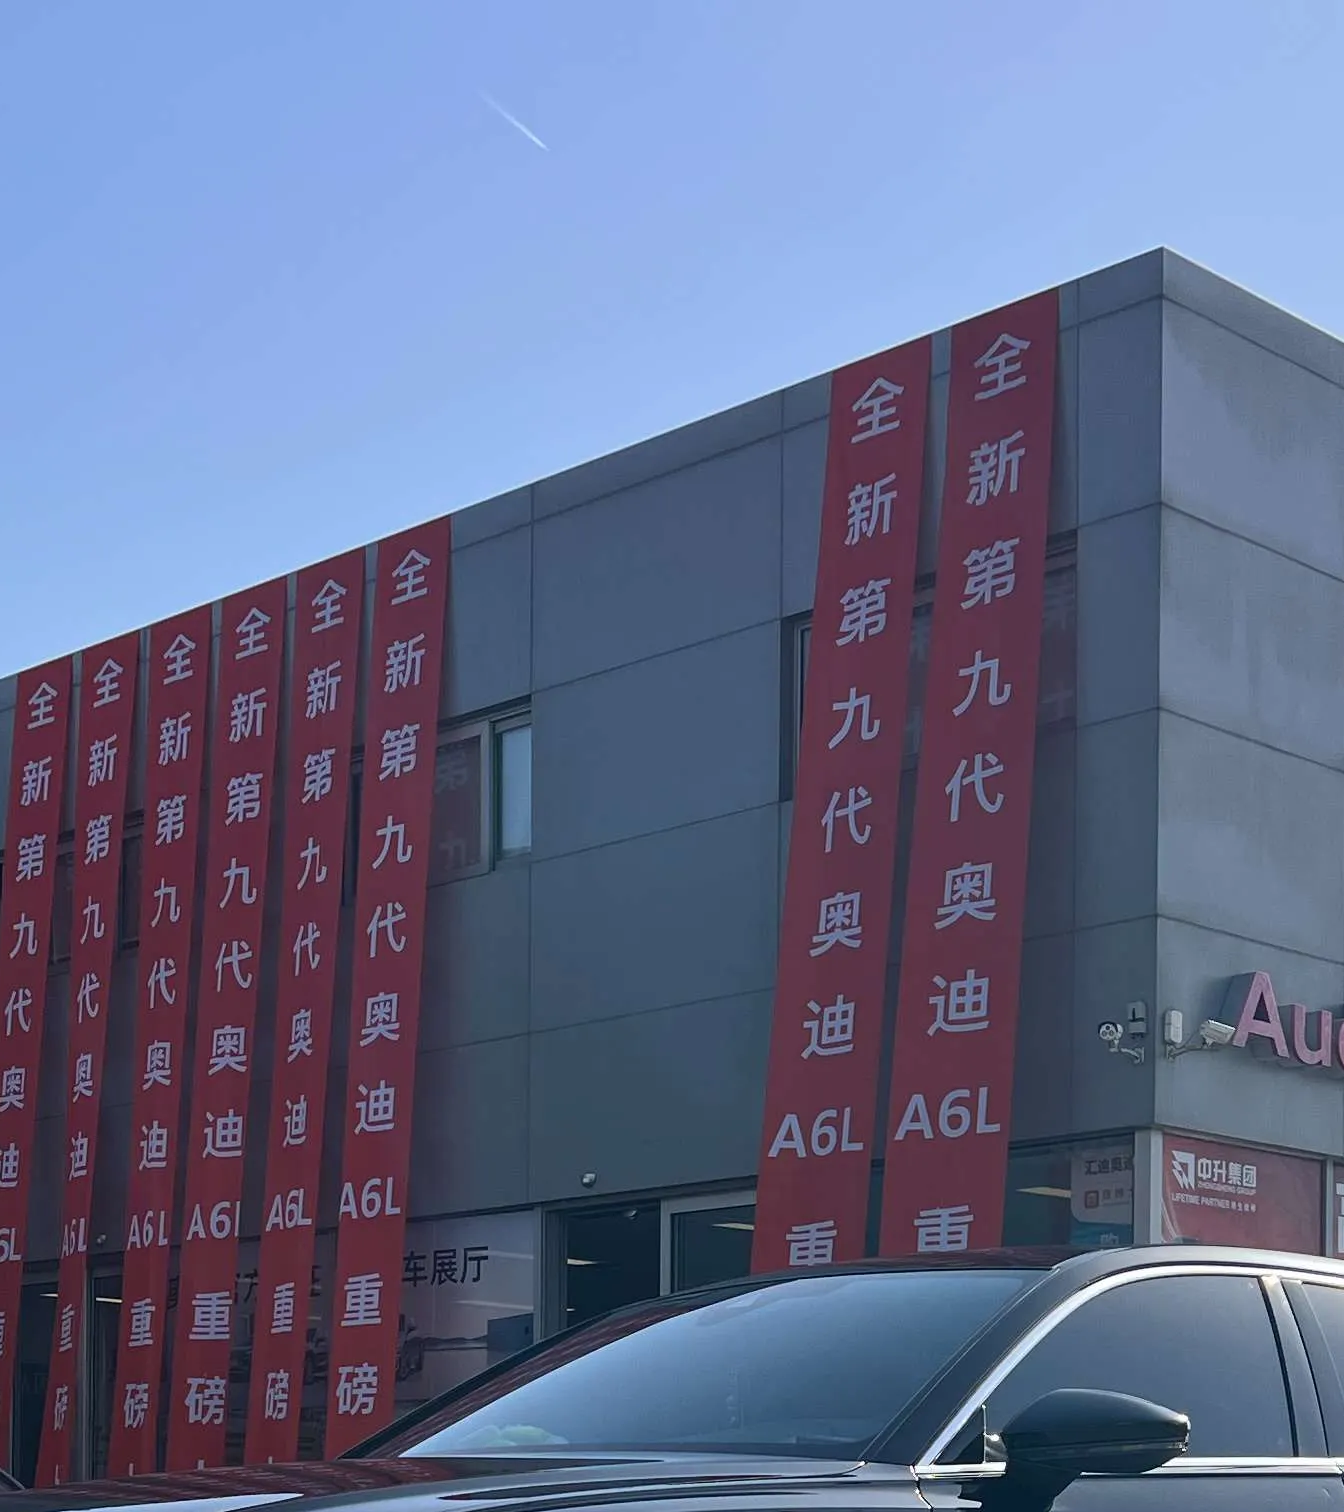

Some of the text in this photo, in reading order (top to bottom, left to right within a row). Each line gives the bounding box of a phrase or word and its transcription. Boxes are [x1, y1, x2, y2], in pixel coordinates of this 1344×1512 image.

[54, 658, 124, 1484] 全新第九代奥迪A6L重磅
[124, 634, 195, 1476] 全新第九代奥迪A6L重磅
[184, 607, 271, 1469] 全新第九代奥迪A6L重磅
[264, 579, 348, 1463] 全新第九代奥迪A6L重磅
[1197, 1157, 1257, 1188] 中升集团
